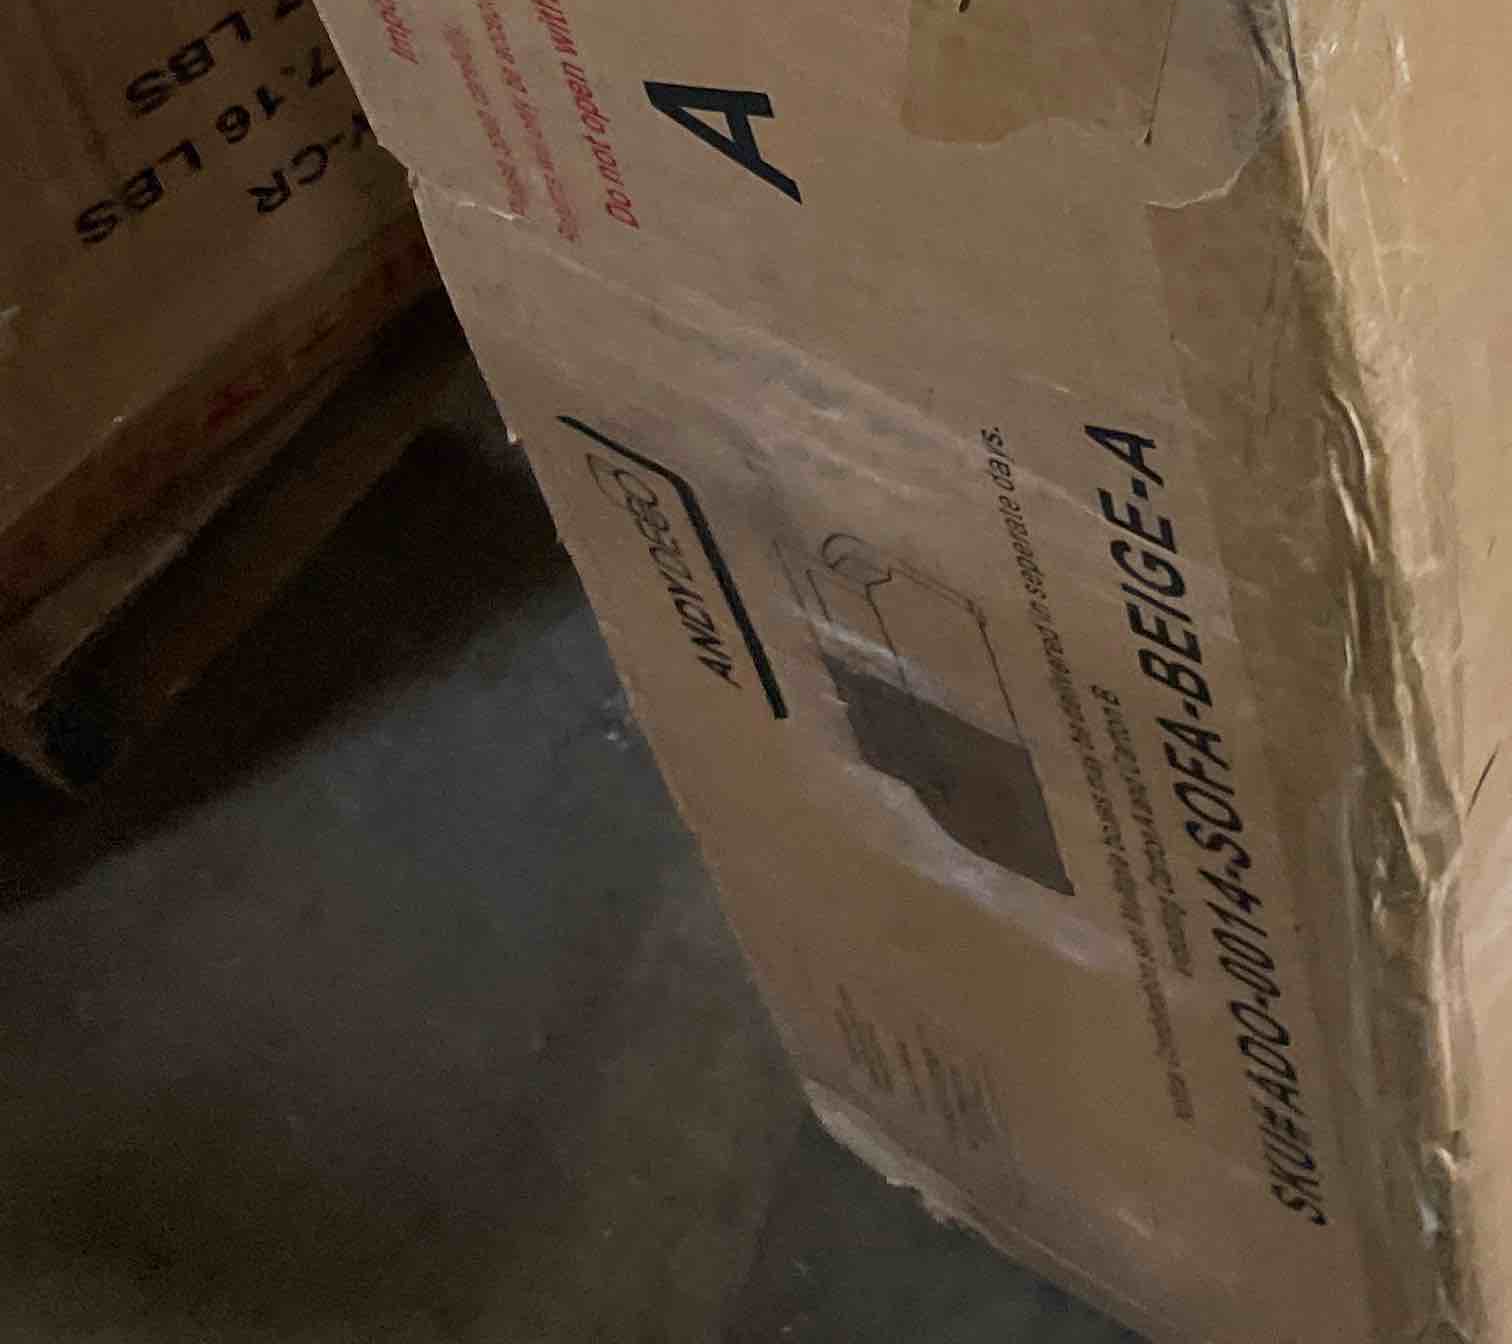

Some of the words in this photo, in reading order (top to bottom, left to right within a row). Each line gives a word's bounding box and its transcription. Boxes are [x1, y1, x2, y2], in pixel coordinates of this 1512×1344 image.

[125, 11, 253, 118] LBS
[561, 61, 610, 134] open
[584, 134, 624, 186] not
[642, 80, 802, 205] A
[75, 140, 203, 245] LBS
[606, 188, 640, 230] Do
